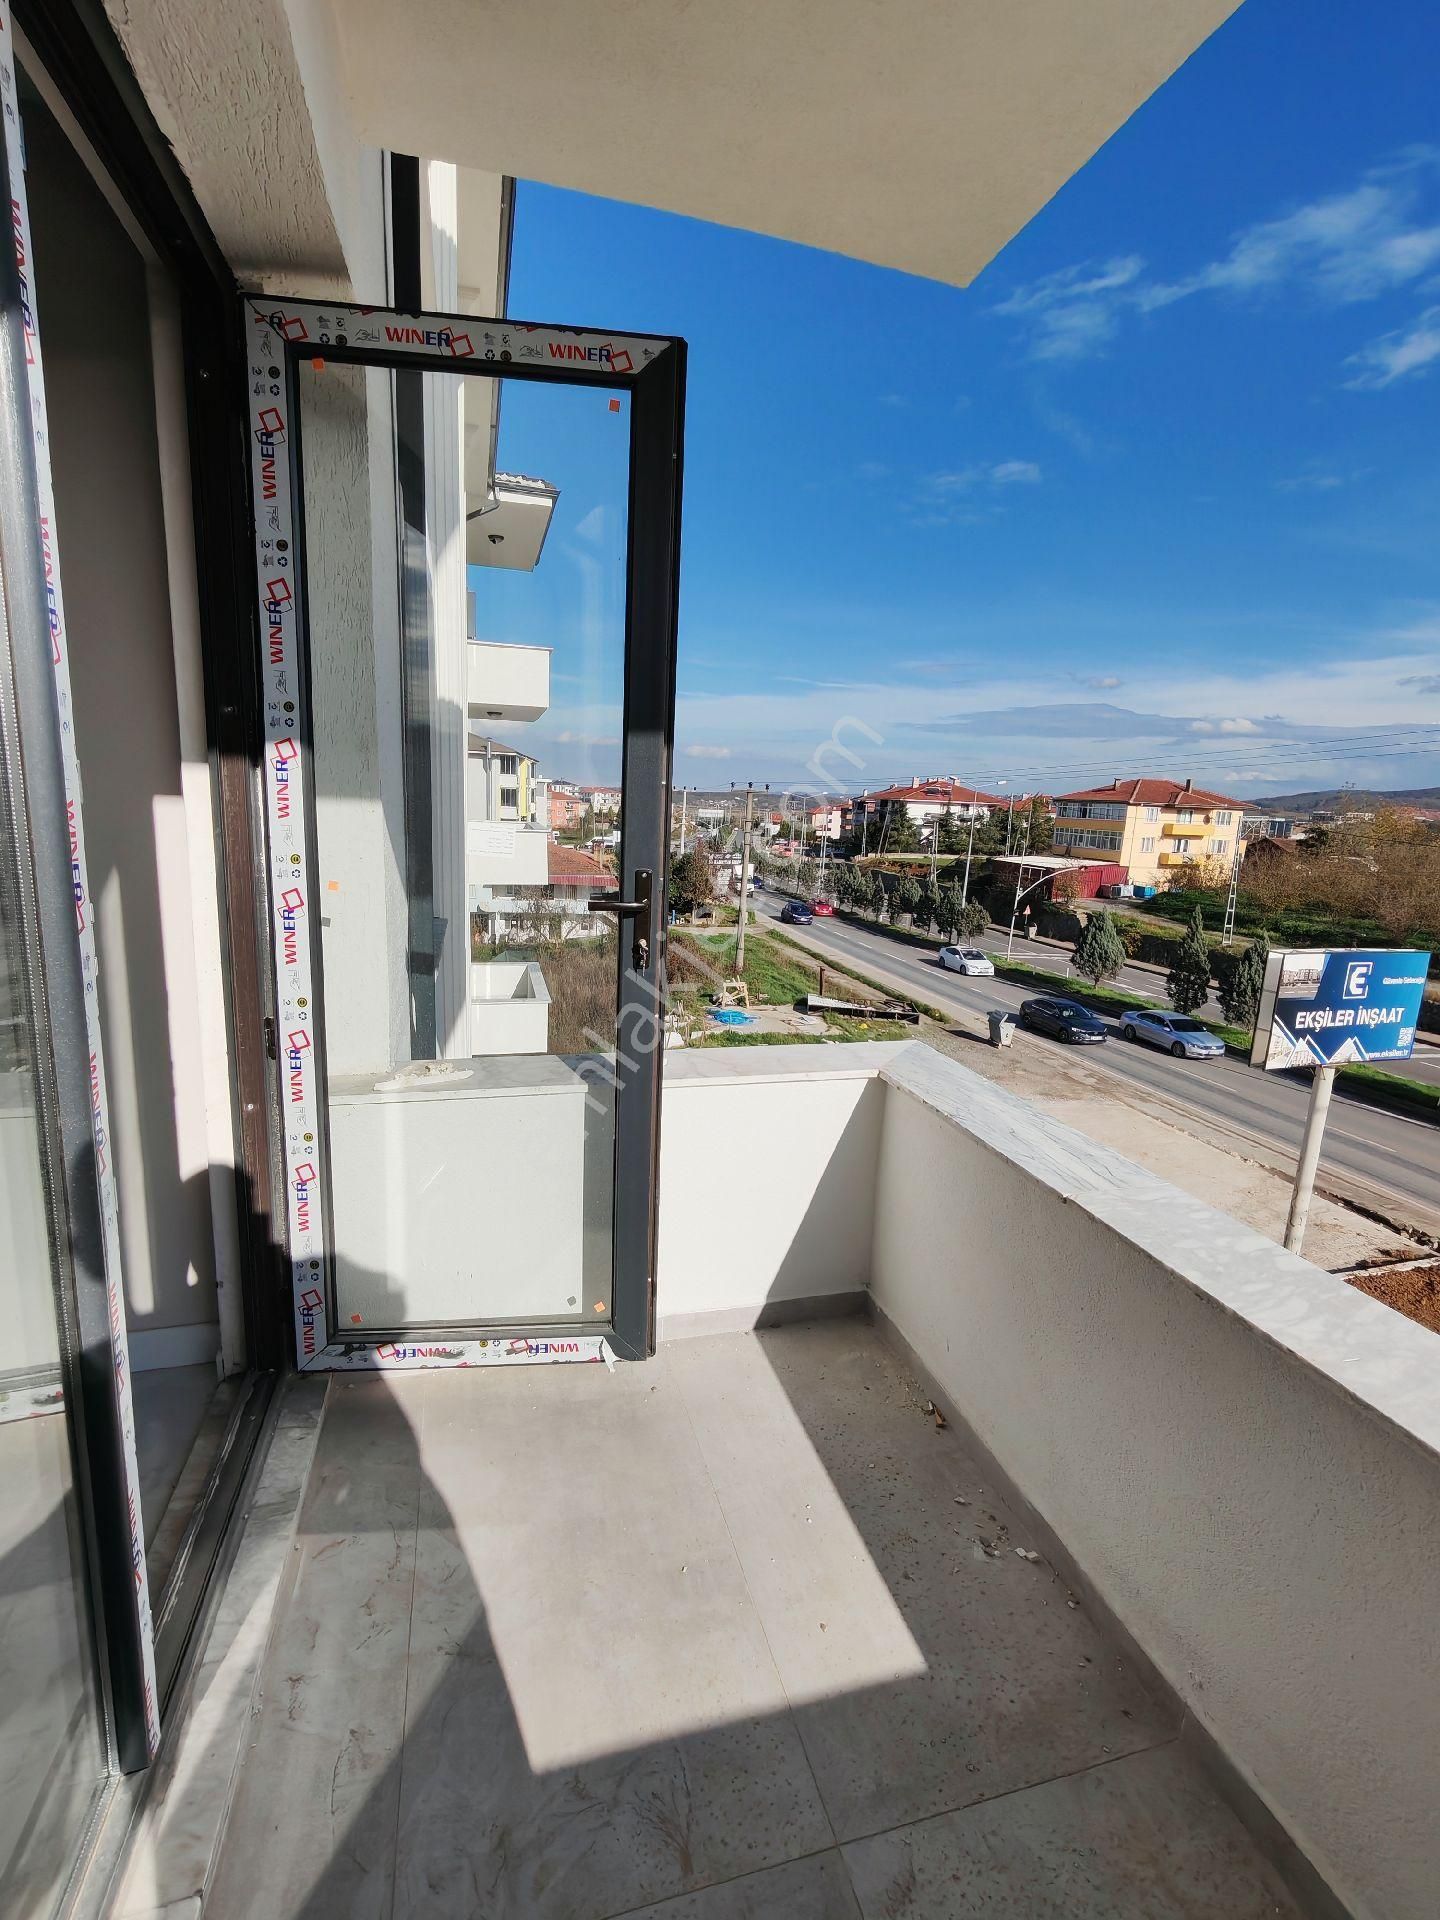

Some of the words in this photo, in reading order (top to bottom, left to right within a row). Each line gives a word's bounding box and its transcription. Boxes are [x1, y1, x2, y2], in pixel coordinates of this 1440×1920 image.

[384, 326, 451, 347] WINER
[549, 342, 612, 362] WINER
[260, 432, 277, 500] WINER
[268, 600, 284, 665] WINER
[276, 759, 291, 819] WINER
[283, 909, 297, 965] WINER
[1295, 1006, 1354, 1033] EKŞİLER
[1356, 1005, 1405, 1029] İNŞAAT
[290, 1050, 304, 1103] WINER
[297, 1182, 310, 1232] WINER
[302, 1306, 316, 1355] WINER
[529, 1343, 579, 1354] WINER
